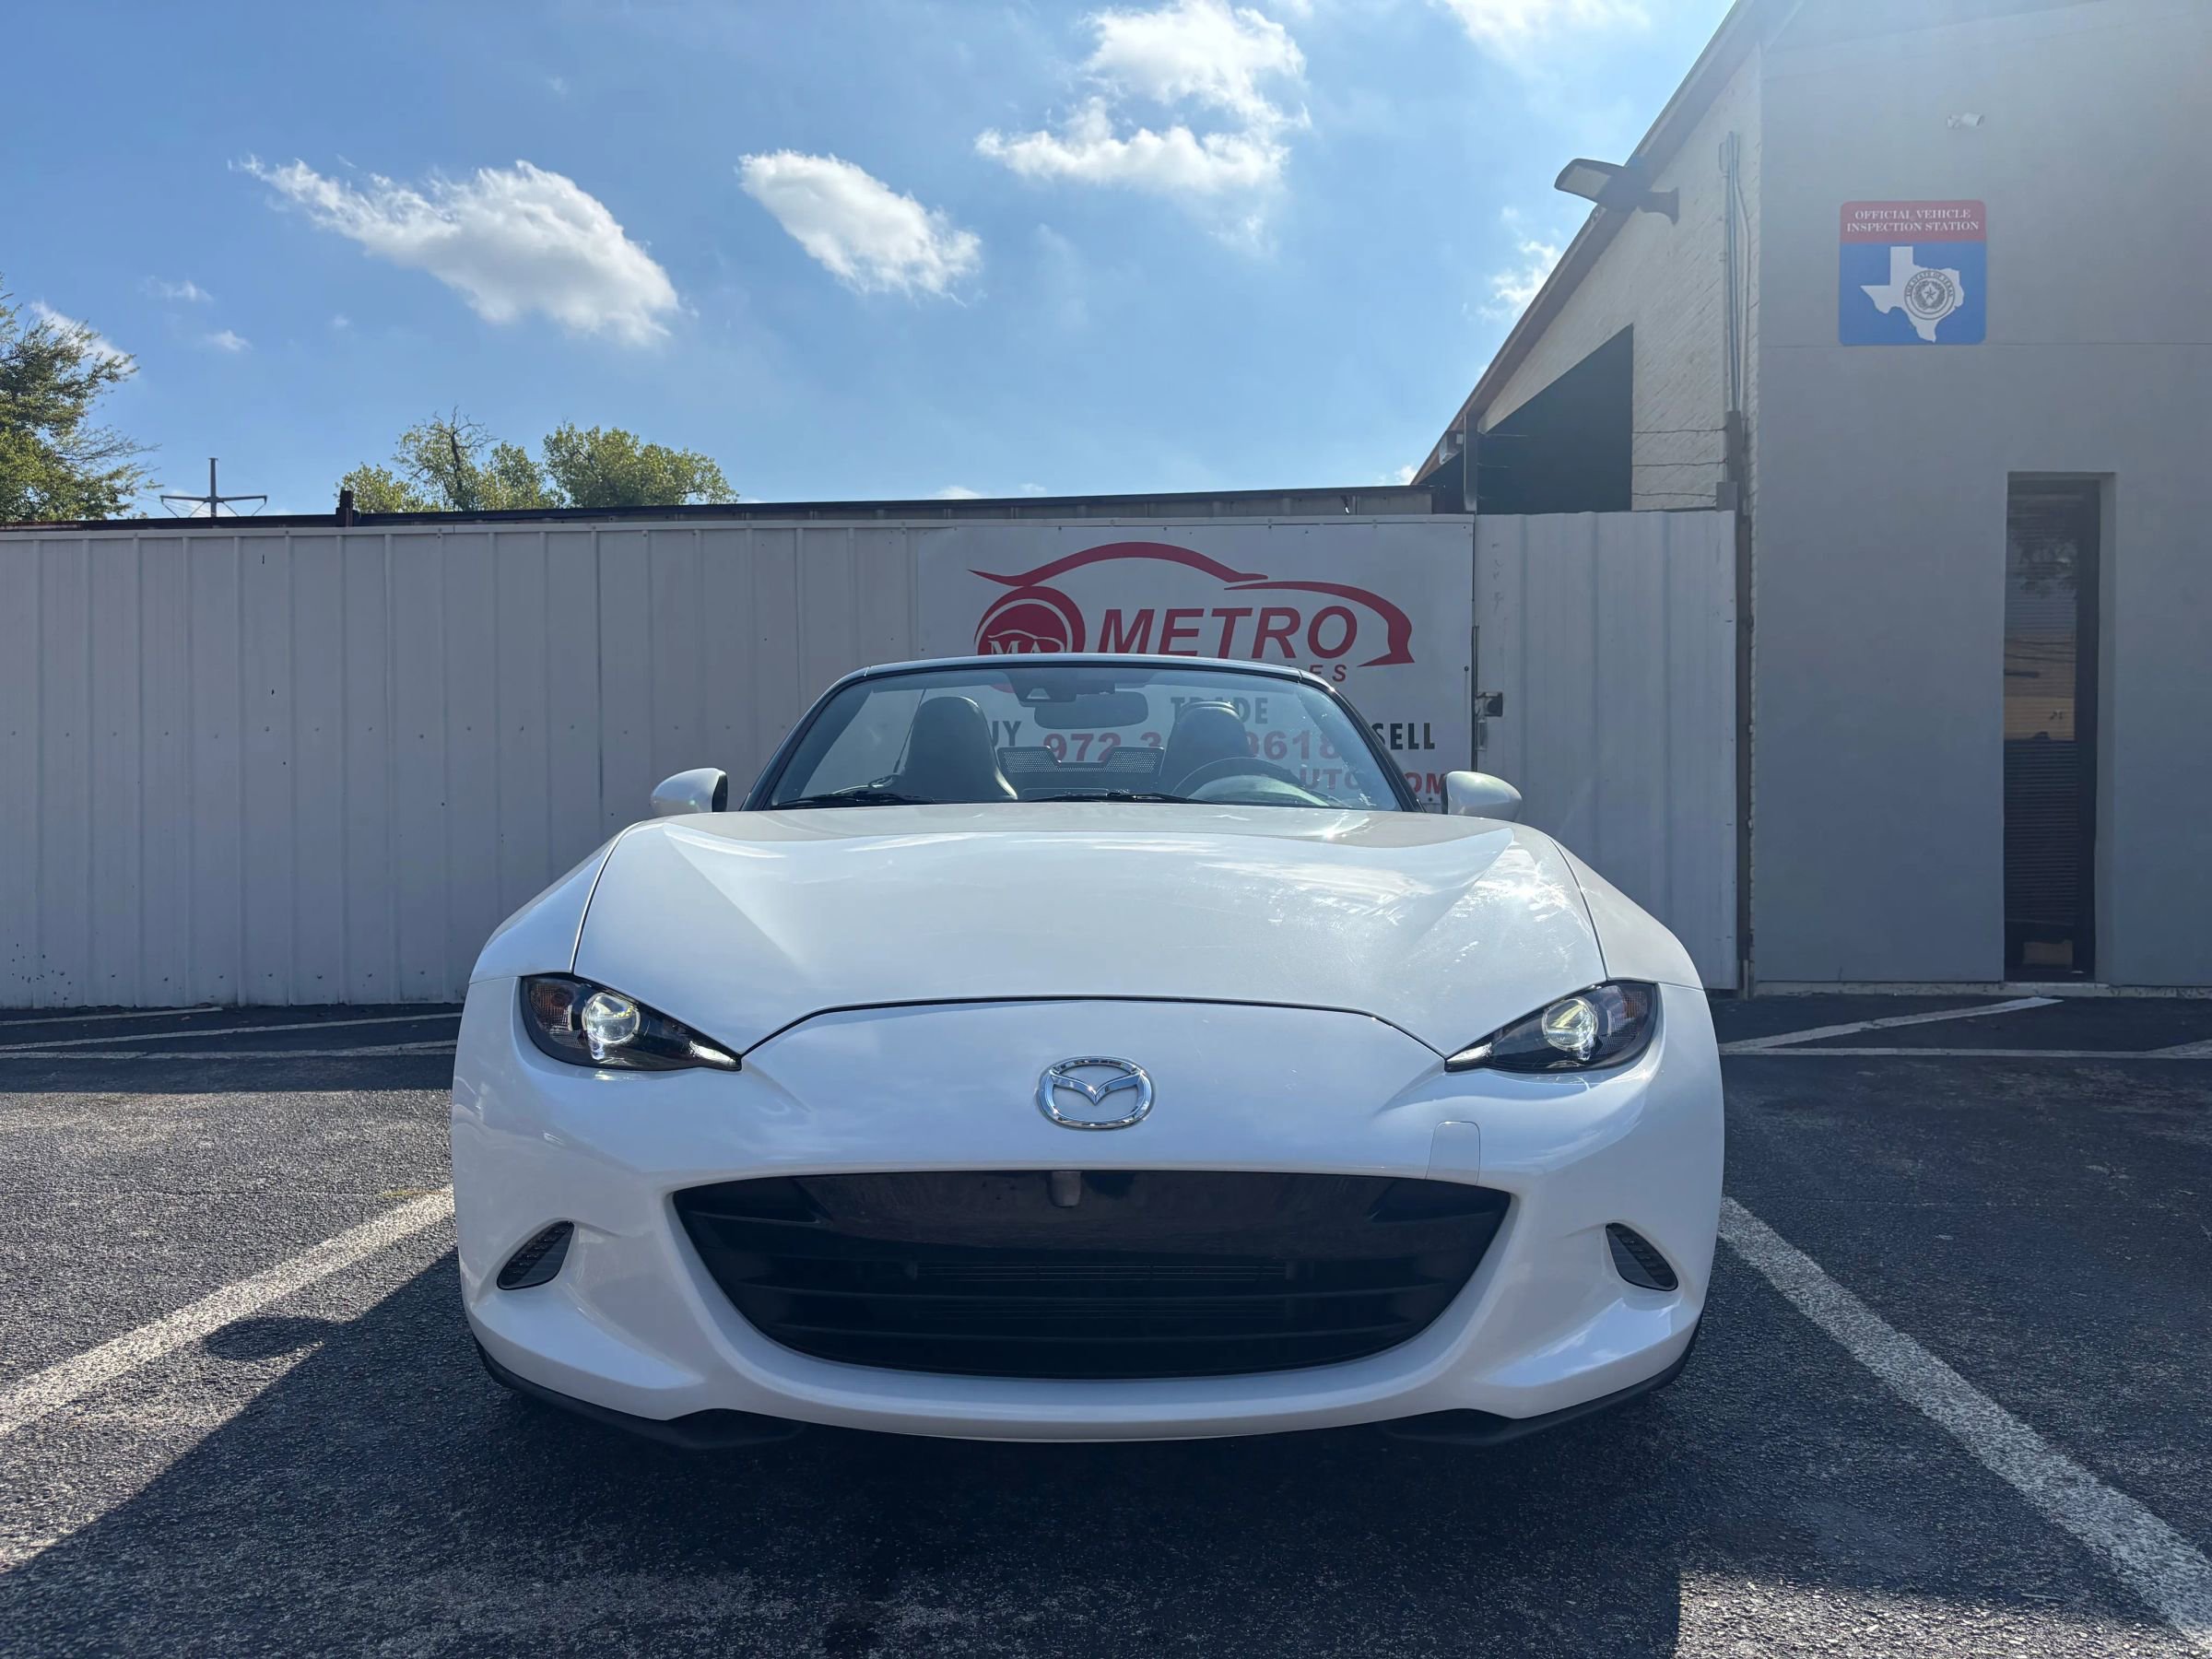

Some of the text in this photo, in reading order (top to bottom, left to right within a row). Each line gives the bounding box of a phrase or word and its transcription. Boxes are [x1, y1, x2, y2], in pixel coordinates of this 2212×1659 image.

[1847, 221, 1979, 232] INSPECTION STATION
[1854, 208, 1971, 220] OFFICIAL VEHICLE
[1098, 606, 1358, 659] METRO
[1171, 697, 1268, 725] TDE
[991, 720, 1022, 747] UY
[1371, 723, 1436, 750] SELL
[1043, 732, 1122, 763] 972
